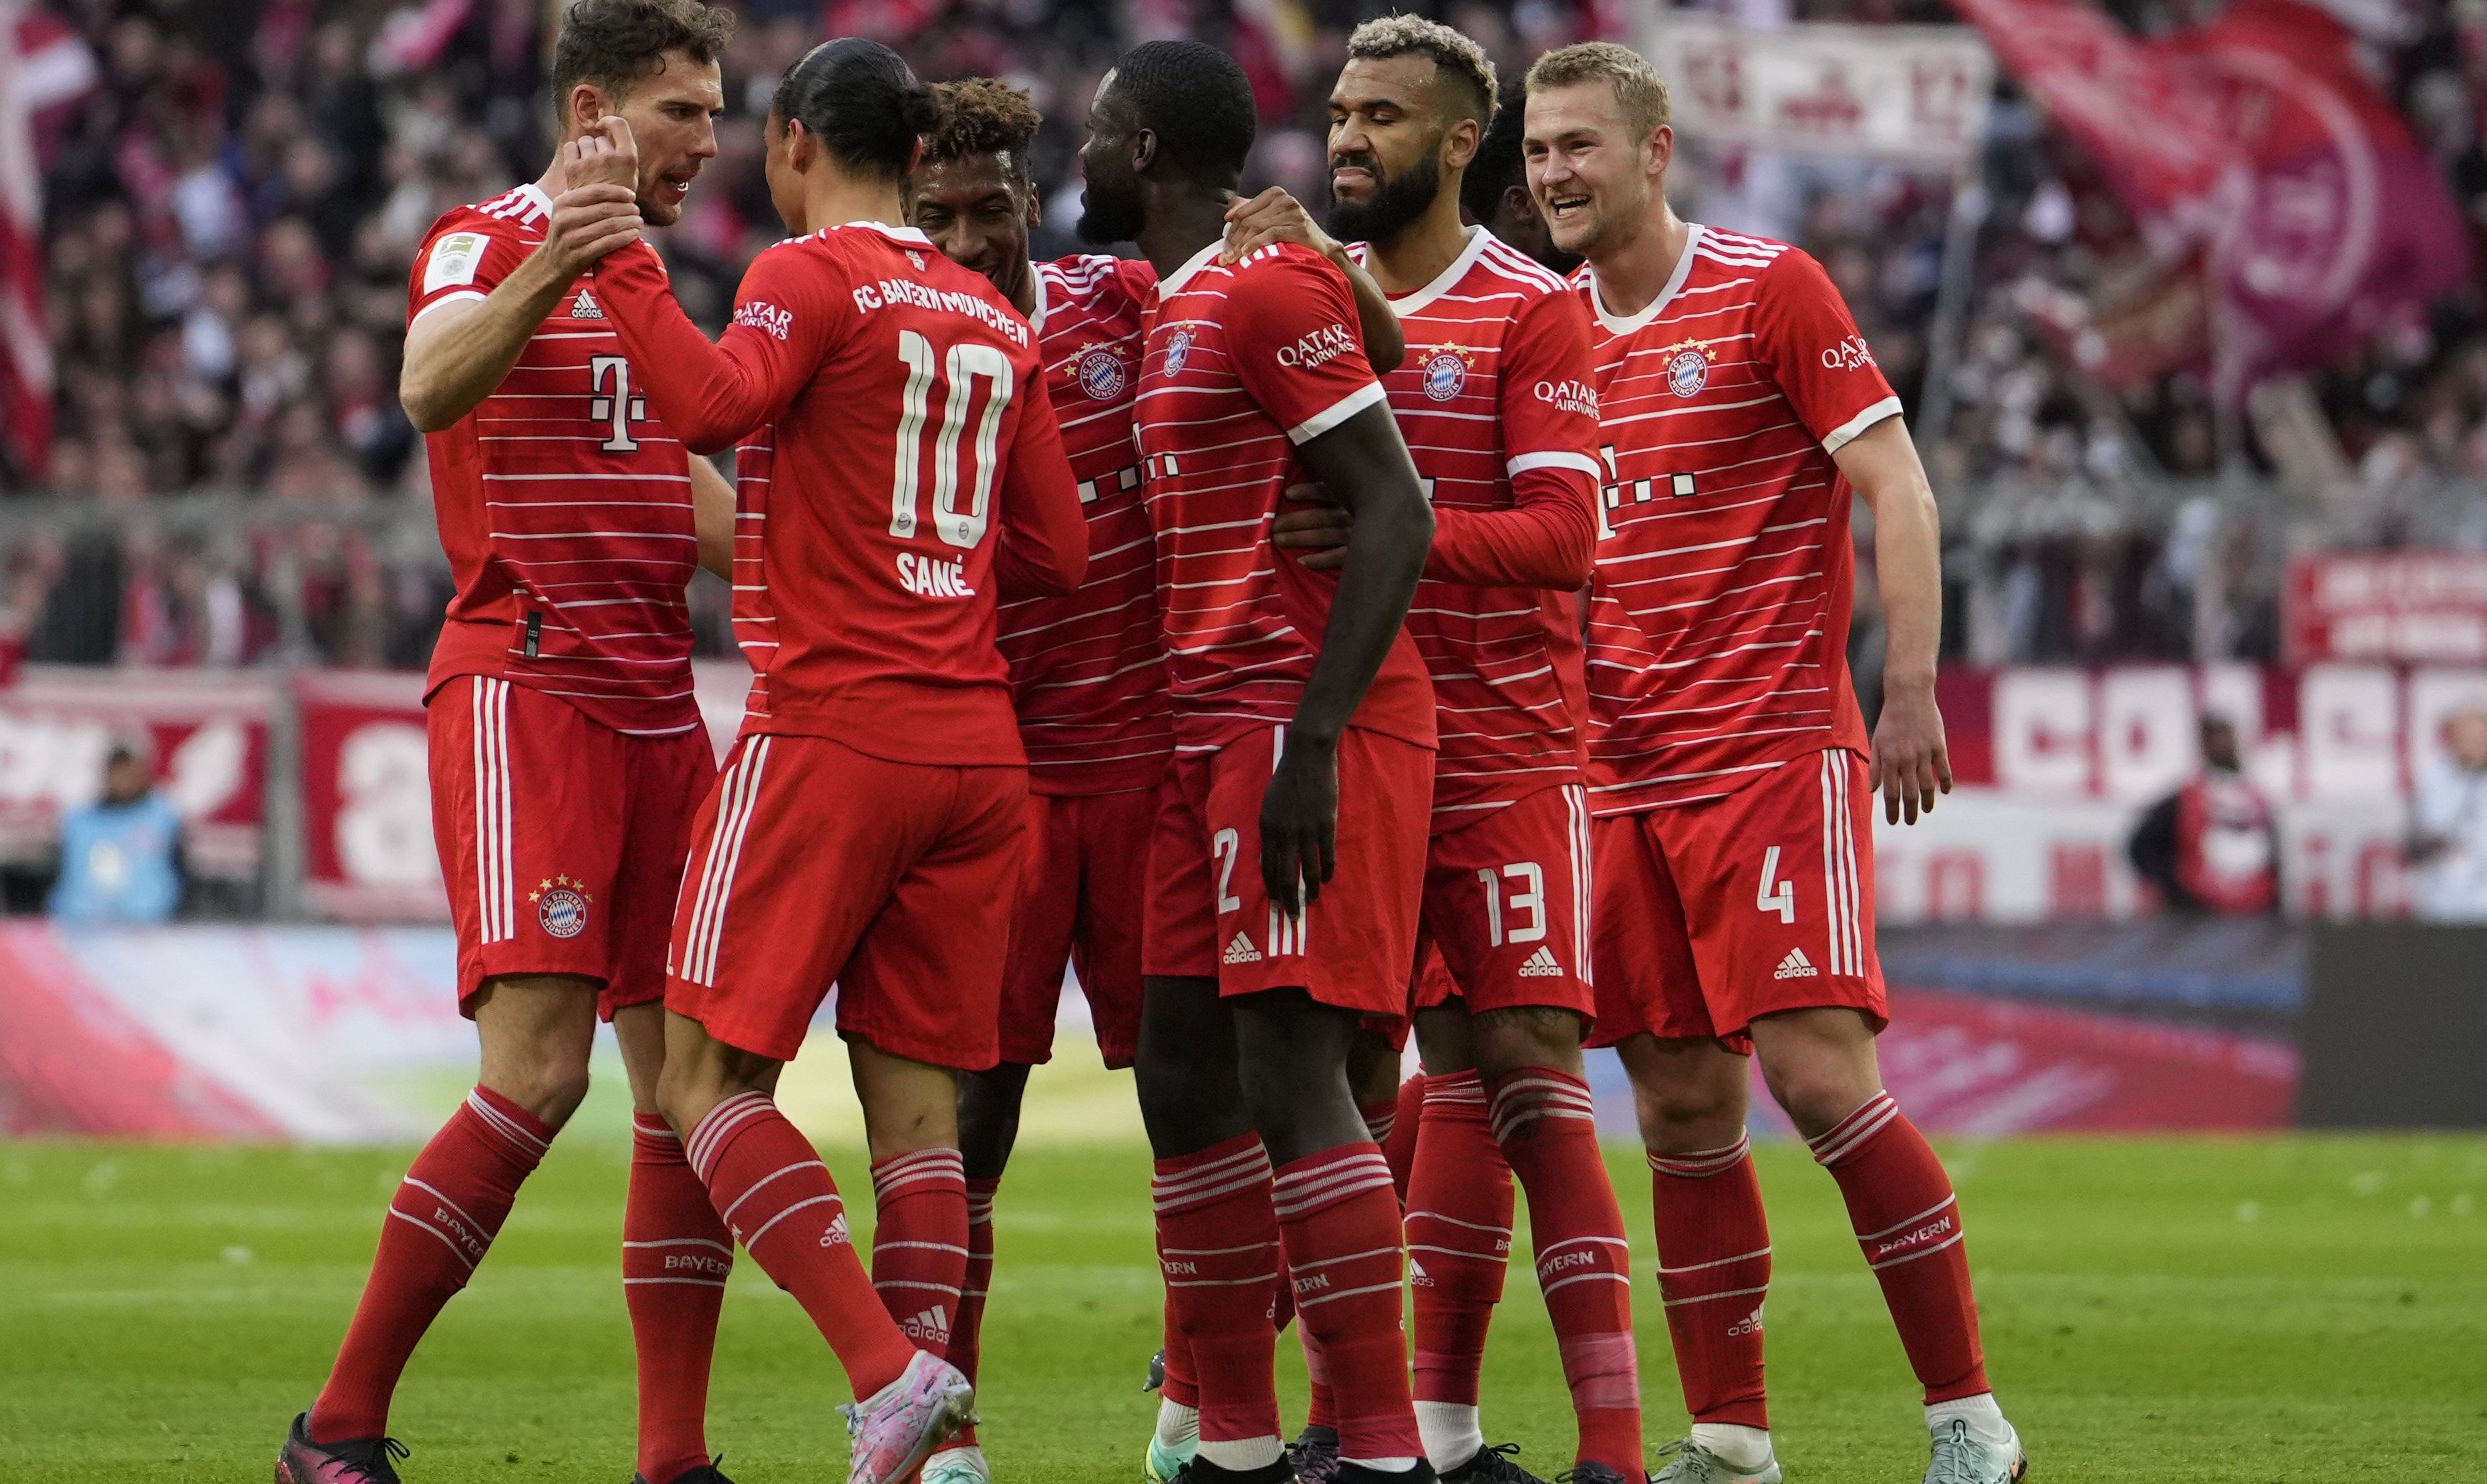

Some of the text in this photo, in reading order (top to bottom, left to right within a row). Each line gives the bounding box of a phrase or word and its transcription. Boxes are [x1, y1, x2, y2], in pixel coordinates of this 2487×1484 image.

[853, 285, 882, 314] FC
[879, 278, 942, 312] BAYERN
[571, 307, 603, 318] adidas
[1277, 323, 1350, 366] QATAR
[1821, 335, 1870, 369] QATR
[1533, 380, 1599, 410] QATAR
[1554, 398, 1601, 421] AIRWAYS
[889, 329, 1013, 549] 10
[896, 553, 976, 598] SANÉ
[1213, 827, 1240, 915] 2
[1757, 845, 1795, 924] 4
[552, 893, 583, 911] BAYERN
[1477, 861, 1547, 947] 13
[1223, 950, 1262, 966] adidas
[1518, 965, 1564, 977] adidas
[1774, 966, 1818, 980] adidas
[1728, 1320, 1763, 1336] adid
